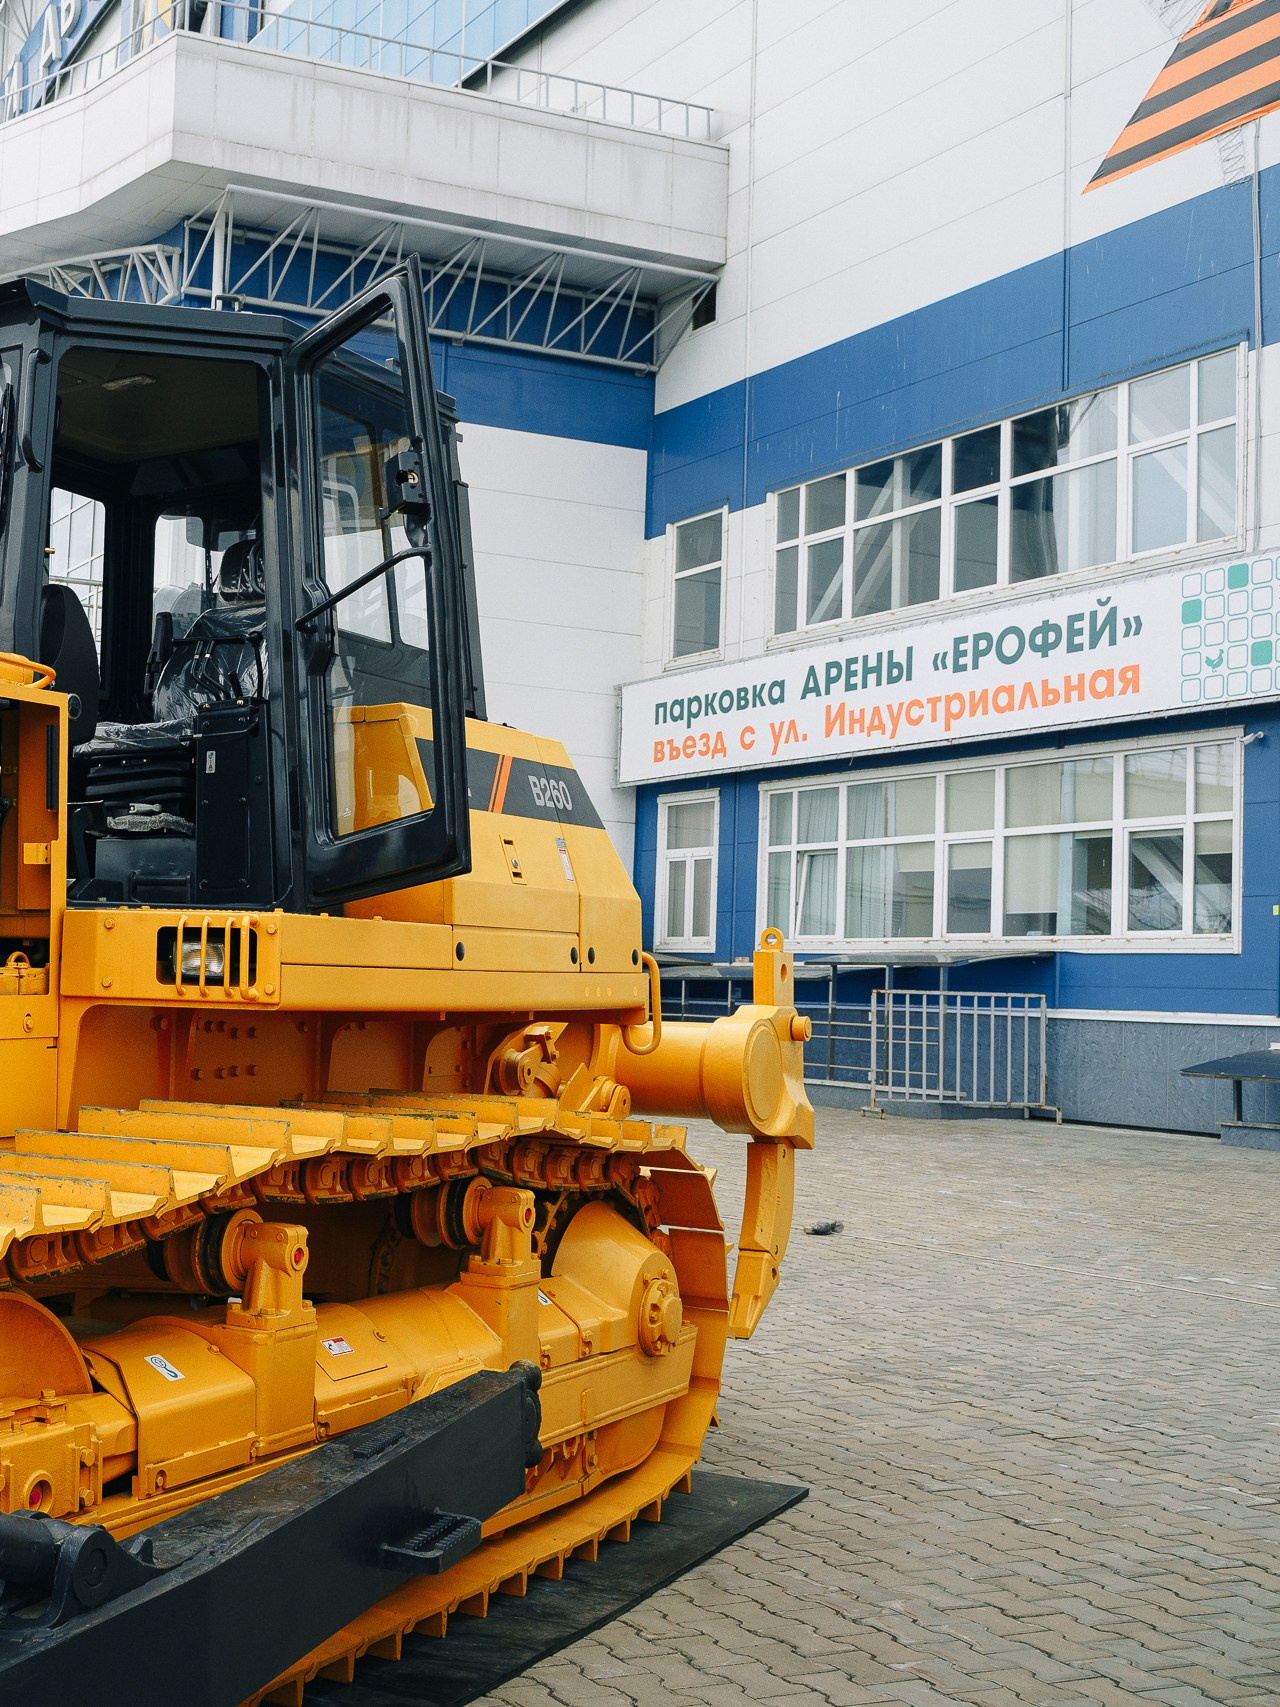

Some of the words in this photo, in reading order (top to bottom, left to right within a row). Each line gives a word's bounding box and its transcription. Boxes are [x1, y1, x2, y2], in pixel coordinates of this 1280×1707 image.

[654, 679, 786, 729] парковка
[800, 645, 914, 700] АРЕНЫ
[932, 596, 1143, 674] «ЕРОФЕЙ»
[653, 730, 727, 763] въезд
[739, 725, 756, 751] с
[769, 719, 808, 756] ул.
[824, 664, 1141, 740] Индустриальная
[528, 774, 573, 811] B260
